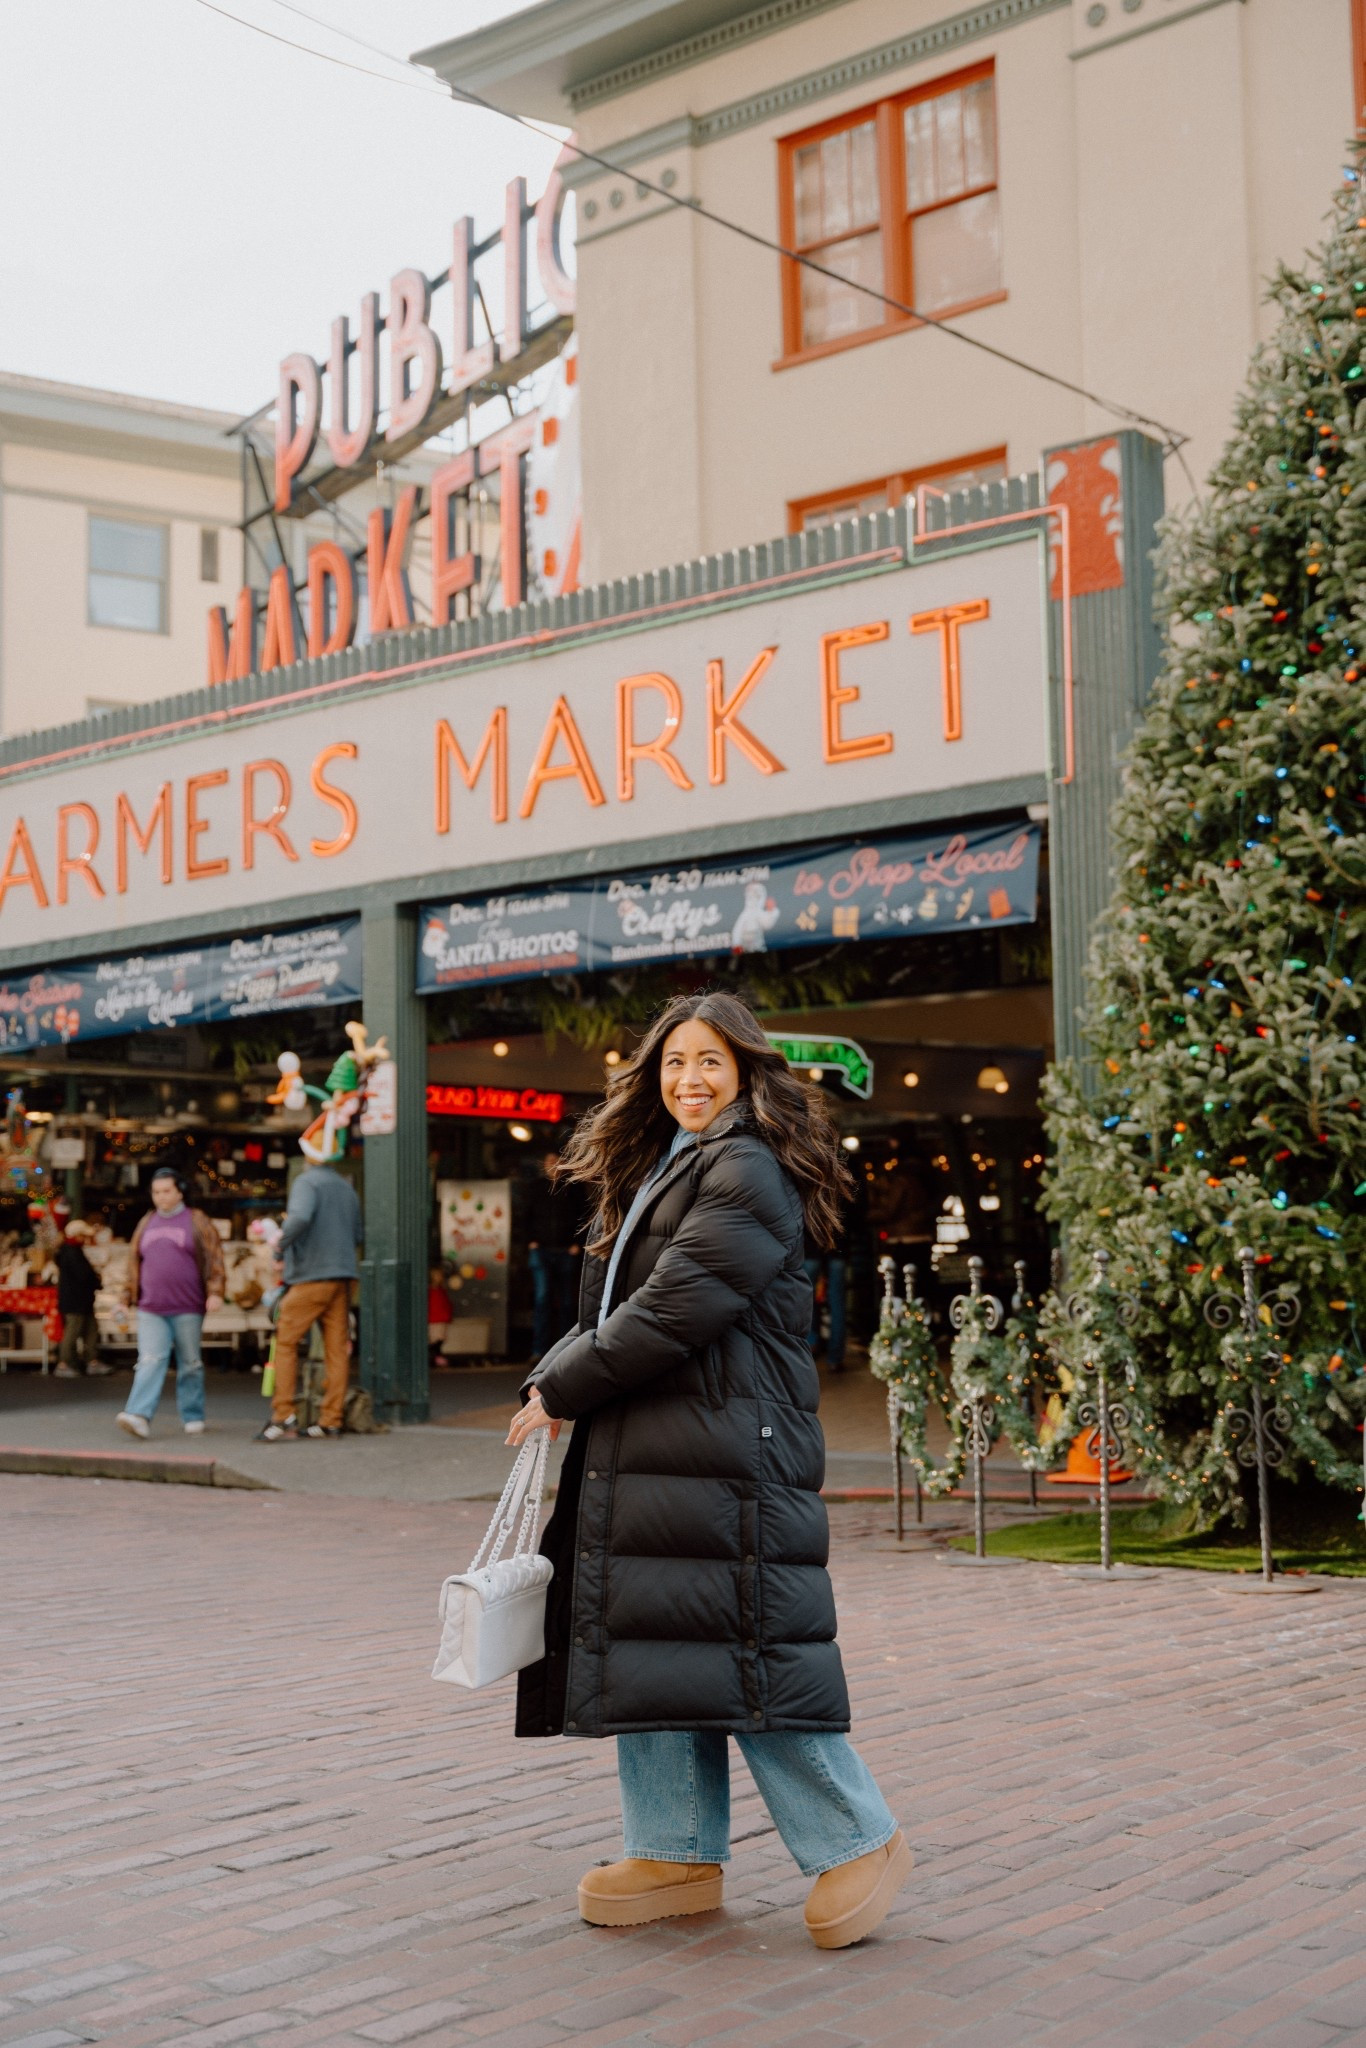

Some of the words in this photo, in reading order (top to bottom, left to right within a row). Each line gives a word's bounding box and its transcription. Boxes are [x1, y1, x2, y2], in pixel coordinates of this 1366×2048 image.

[435, 598, 990, 834] MARKET
[607, 880, 646, 902] Dec.
[650, 869, 702, 896] 16-20
[793, 870, 823, 895] to
[828, 847, 914, 899] Shop
[919, 834, 1029, 886] Local
[450, 903, 484, 925] Dec.
[435, 942, 496, 970] SANTA
[497, 929, 579, 961] PHOTOS
